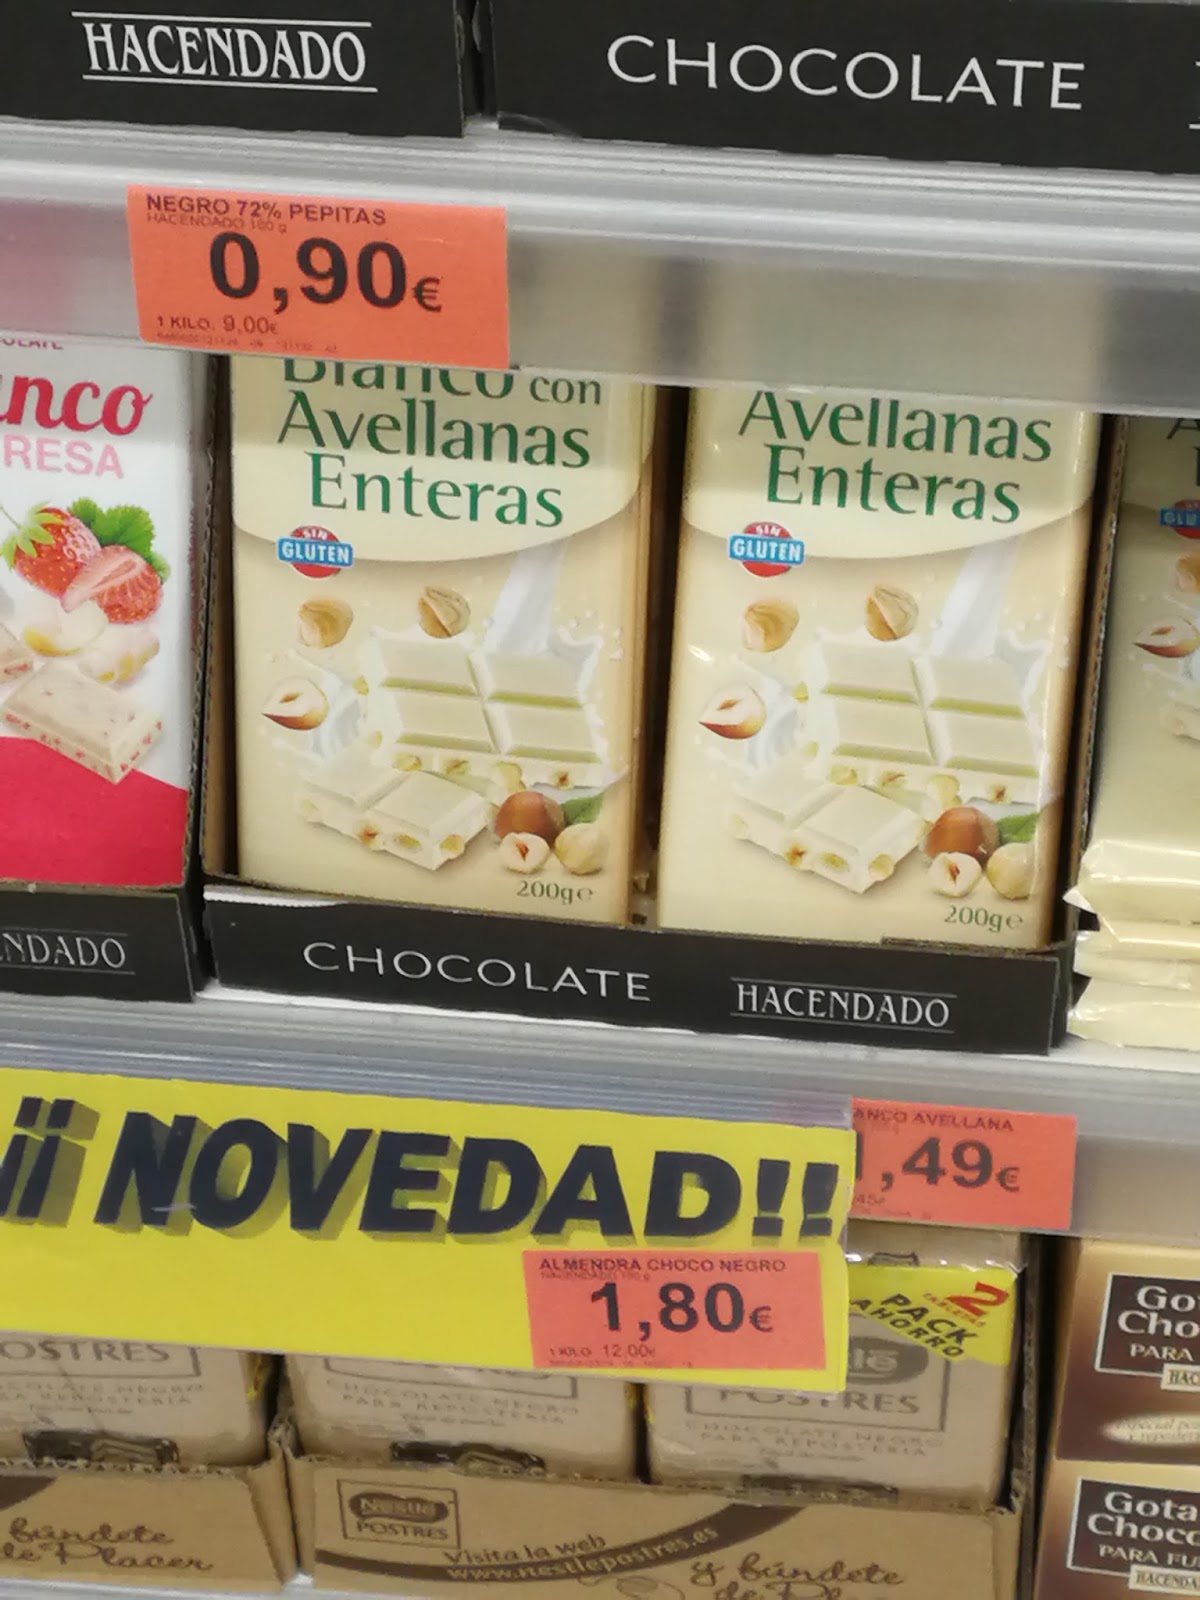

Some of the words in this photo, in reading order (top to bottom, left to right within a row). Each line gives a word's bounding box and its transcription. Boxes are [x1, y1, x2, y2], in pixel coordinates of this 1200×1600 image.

[83, 23, 366, 82] HACENDADO
[607, 34, 1085, 111] CHOCOLATE
[147, 194, 230, 215] NEGRO
[237, 200, 282, 219] 72%
[289, 203, 386, 226] PEPITAS
[209, 231, 442, 314] 0,90€
[529, 375, 602, 405] con
[277, 389, 591, 469] Avellanas
[739, 390, 1052, 462] Avellanas
[303, 450, 564, 528] Enteras
[764, 443, 1021, 524] Enteras
[280, 543, 350, 565] GLUTEN
[303, 528, 328, 540] SIN
[732, 537, 803, 563] GLUTEN
[303, 941, 651, 1003] CHOCOLATE
[736, 983, 950, 1028] HACENDADO
[912, 1110, 1014, 1132] AVELLANA
[539, 1258, 641, 1271] ALMENDRA
[646, 1259, 715, 1272] CHOCO
[719, 1259, 786, 1273] NEGRO
[591, 1281, 774, 1341] 1,80€
[881, 1293, 978, 1346] PACK
[946, 1281, 1010, 1317] 2
[851, 1299, 965, 1357] AHORRO
[1129, 1343, 1195, 1362] PARA
[554, 1534, 606, 1554] web
[1099, 1543, 1159, 1564] PARA
